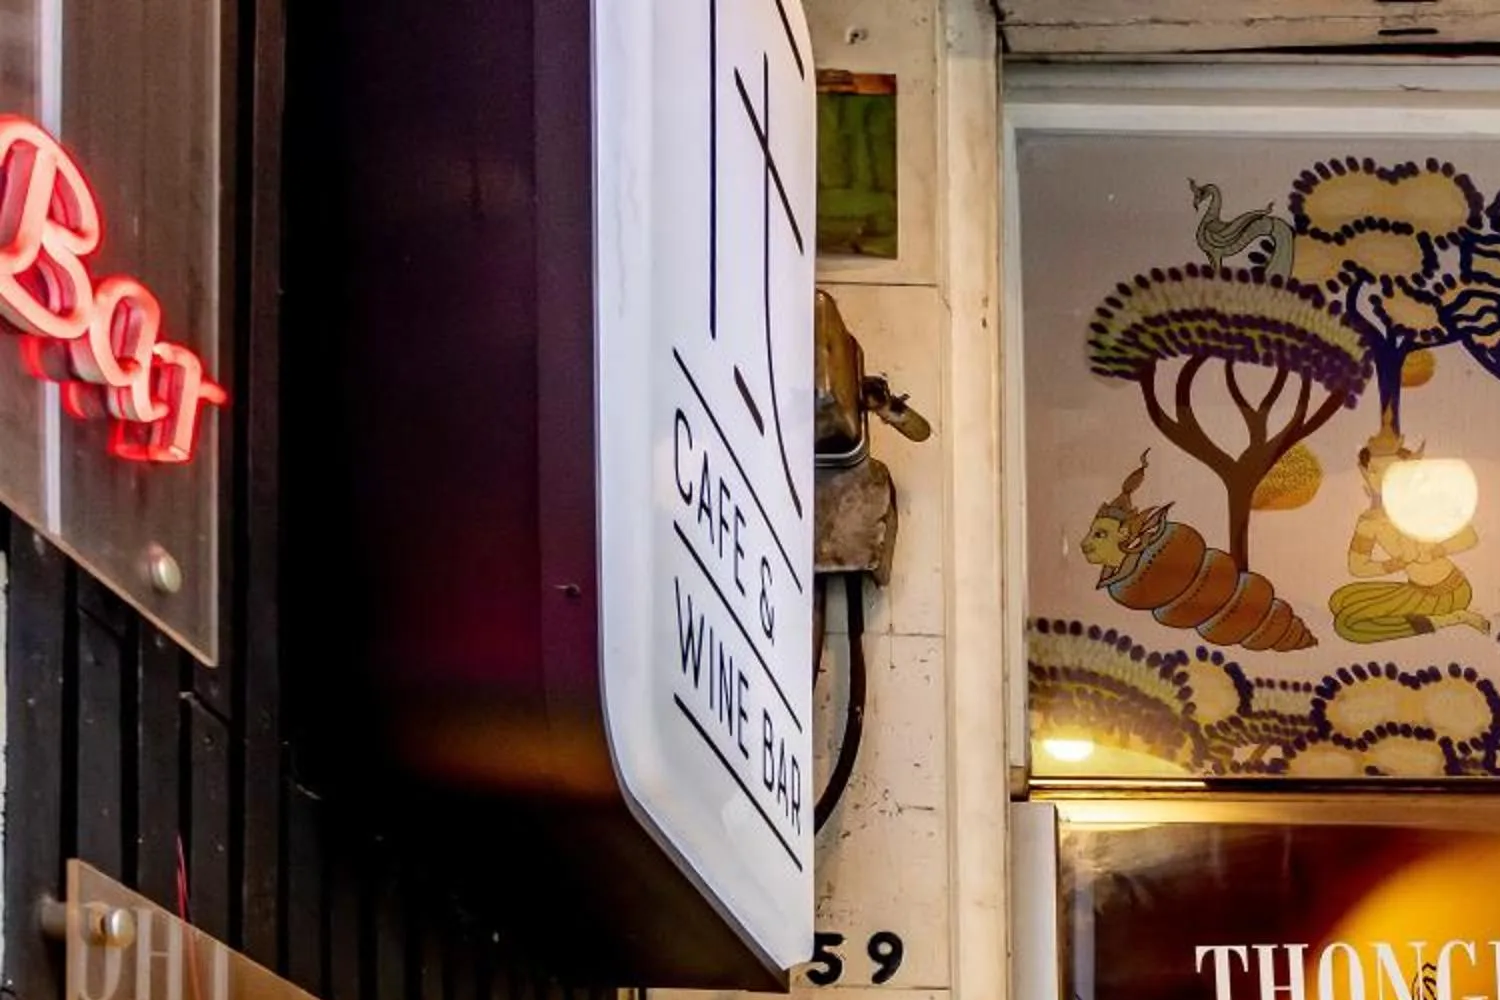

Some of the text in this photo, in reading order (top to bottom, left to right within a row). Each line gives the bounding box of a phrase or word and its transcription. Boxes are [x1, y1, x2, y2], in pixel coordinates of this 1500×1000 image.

[673, 407, 776, 646] CAFE &
[674, 577, 801, 836] WINE BAR
[804, 931, 905, 986] 59
